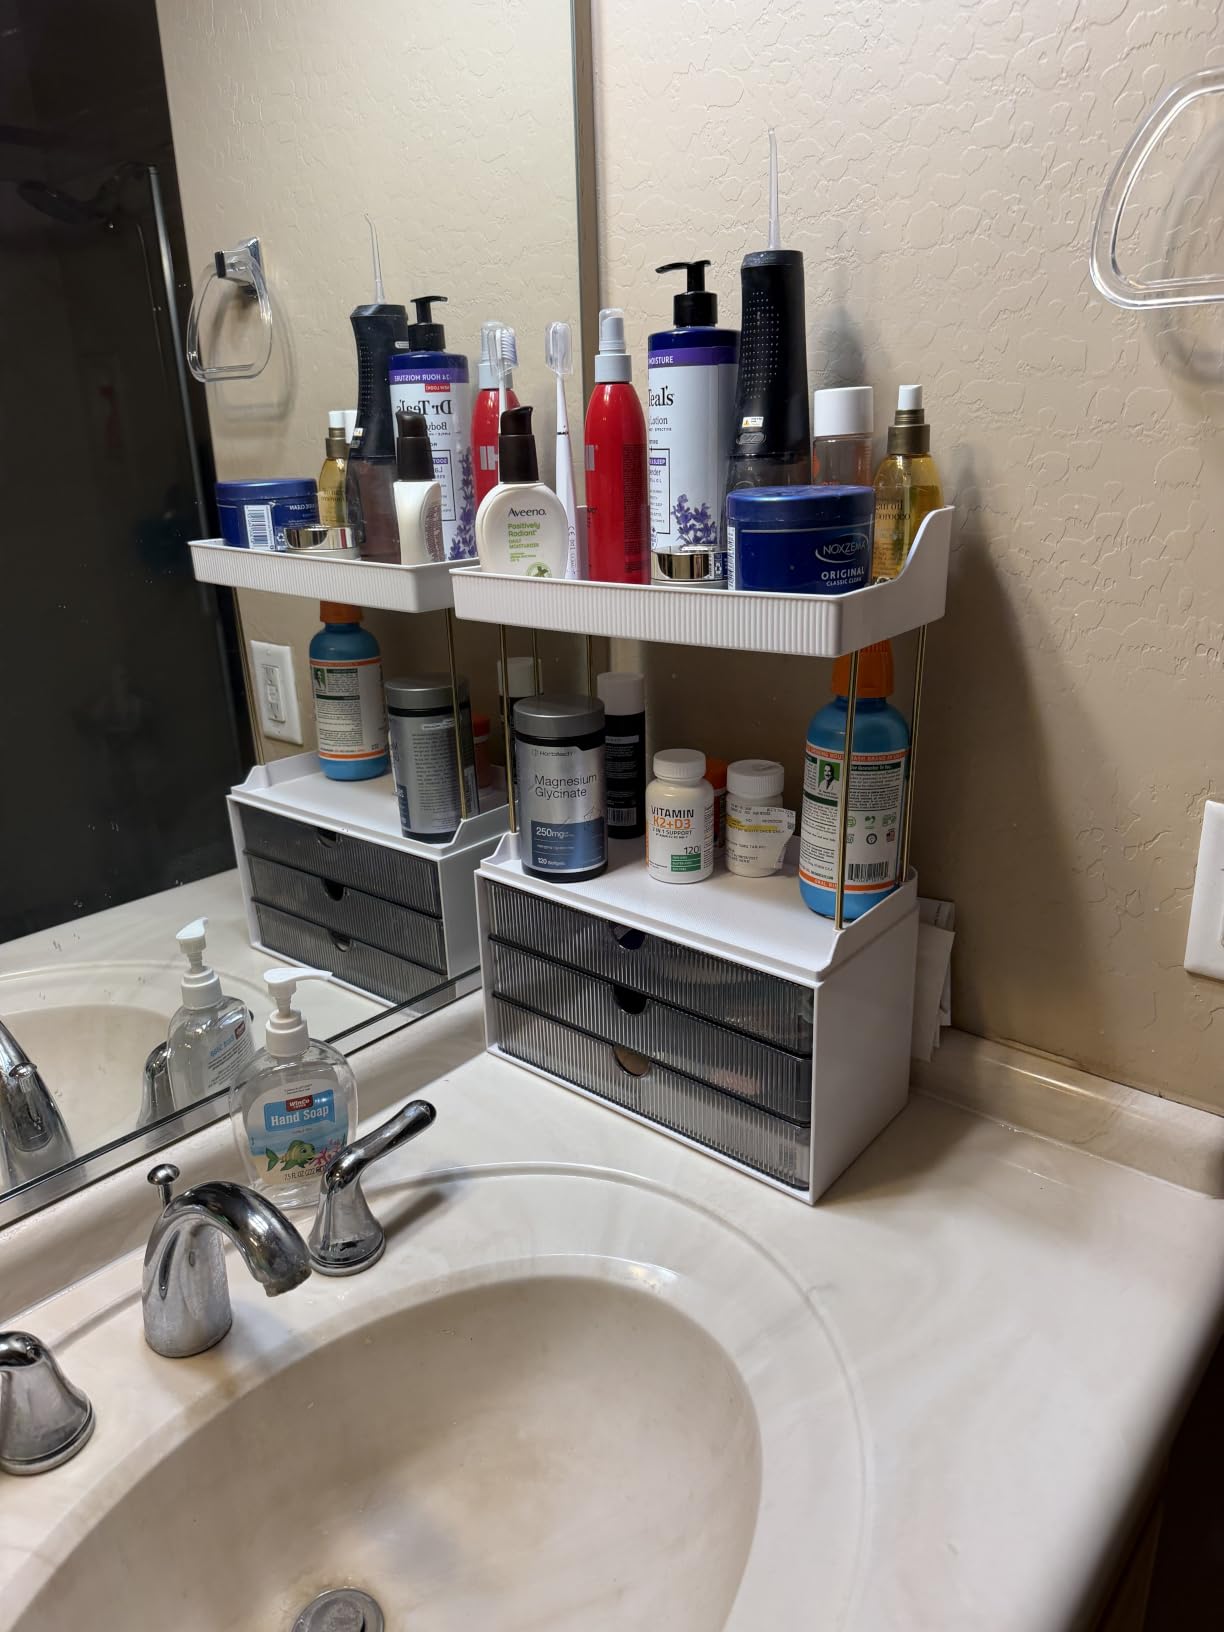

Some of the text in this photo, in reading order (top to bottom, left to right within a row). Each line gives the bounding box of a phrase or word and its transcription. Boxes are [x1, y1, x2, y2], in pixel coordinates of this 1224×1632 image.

[649, 355, 674, 365] OISTURE
[508, 522, 541, 530] Positively
[823, 540, 866, 555] NOXZEMA
[821, 566, 865, 580] ORIGINAL
[826, 578, 848, 587] CLASSIC
[534, 774, 597, 789] Magnesium
[535, 786, 587, 800] Glycinate
[651, 805, 694, 818] VITAMIN
[653, 815, 691, 830] K2+D3
[536, 826, 565, 839] 250mg
[684, 845, 700, 855] 120
[271, 1105, 330, 1126] Hand Soap
